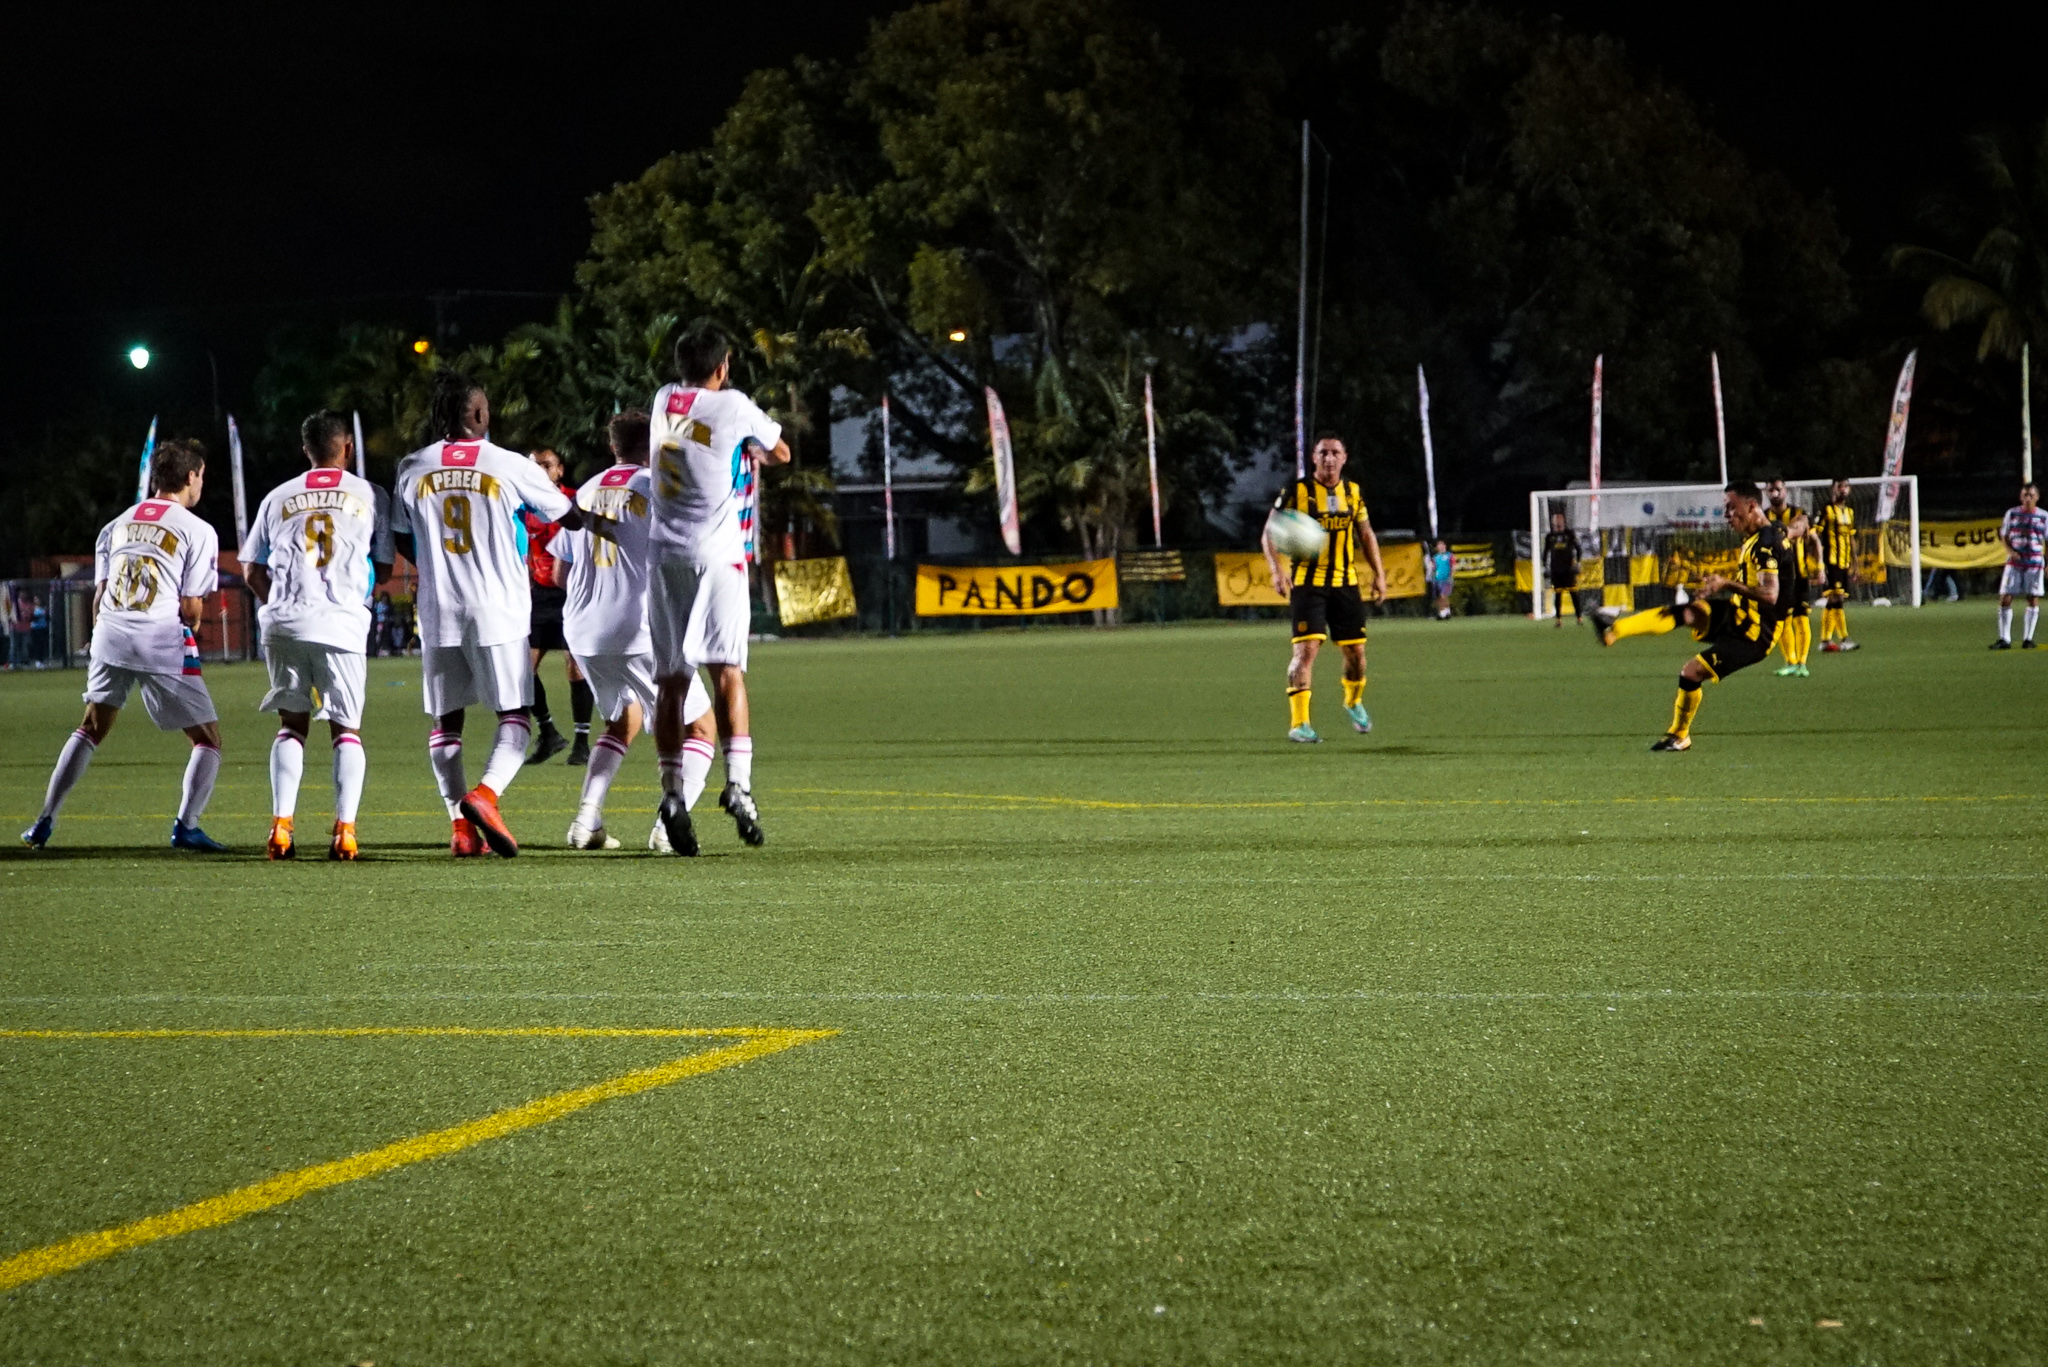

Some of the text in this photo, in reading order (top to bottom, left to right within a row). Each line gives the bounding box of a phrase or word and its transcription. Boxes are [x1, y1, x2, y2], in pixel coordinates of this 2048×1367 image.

[432, 471, 482, 491] PEREA
[443, 494, 472, 555] 9
[938, 573, 1094, 609] PANDO
